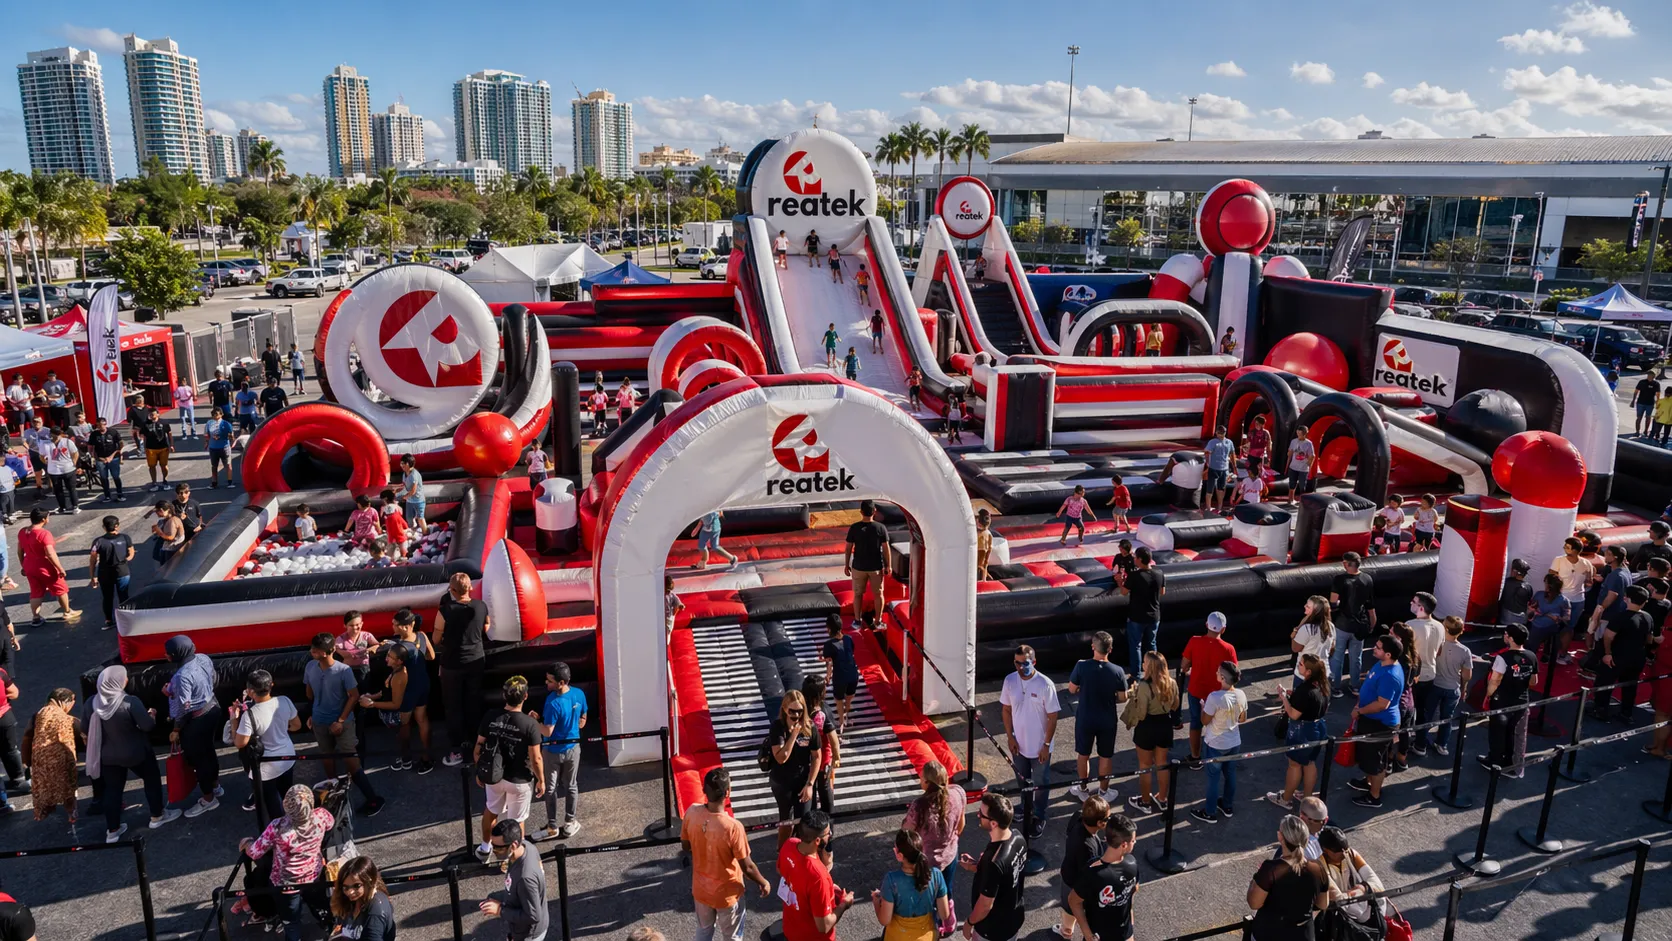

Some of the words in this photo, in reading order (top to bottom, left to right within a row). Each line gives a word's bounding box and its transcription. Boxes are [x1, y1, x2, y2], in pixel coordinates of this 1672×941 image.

[768, 189, 866, 216] reatek
[955, 211, 984, 220] reatek
[1375, 368, 1448, 397] reatek
[766, 467, 855, 496] reatek
